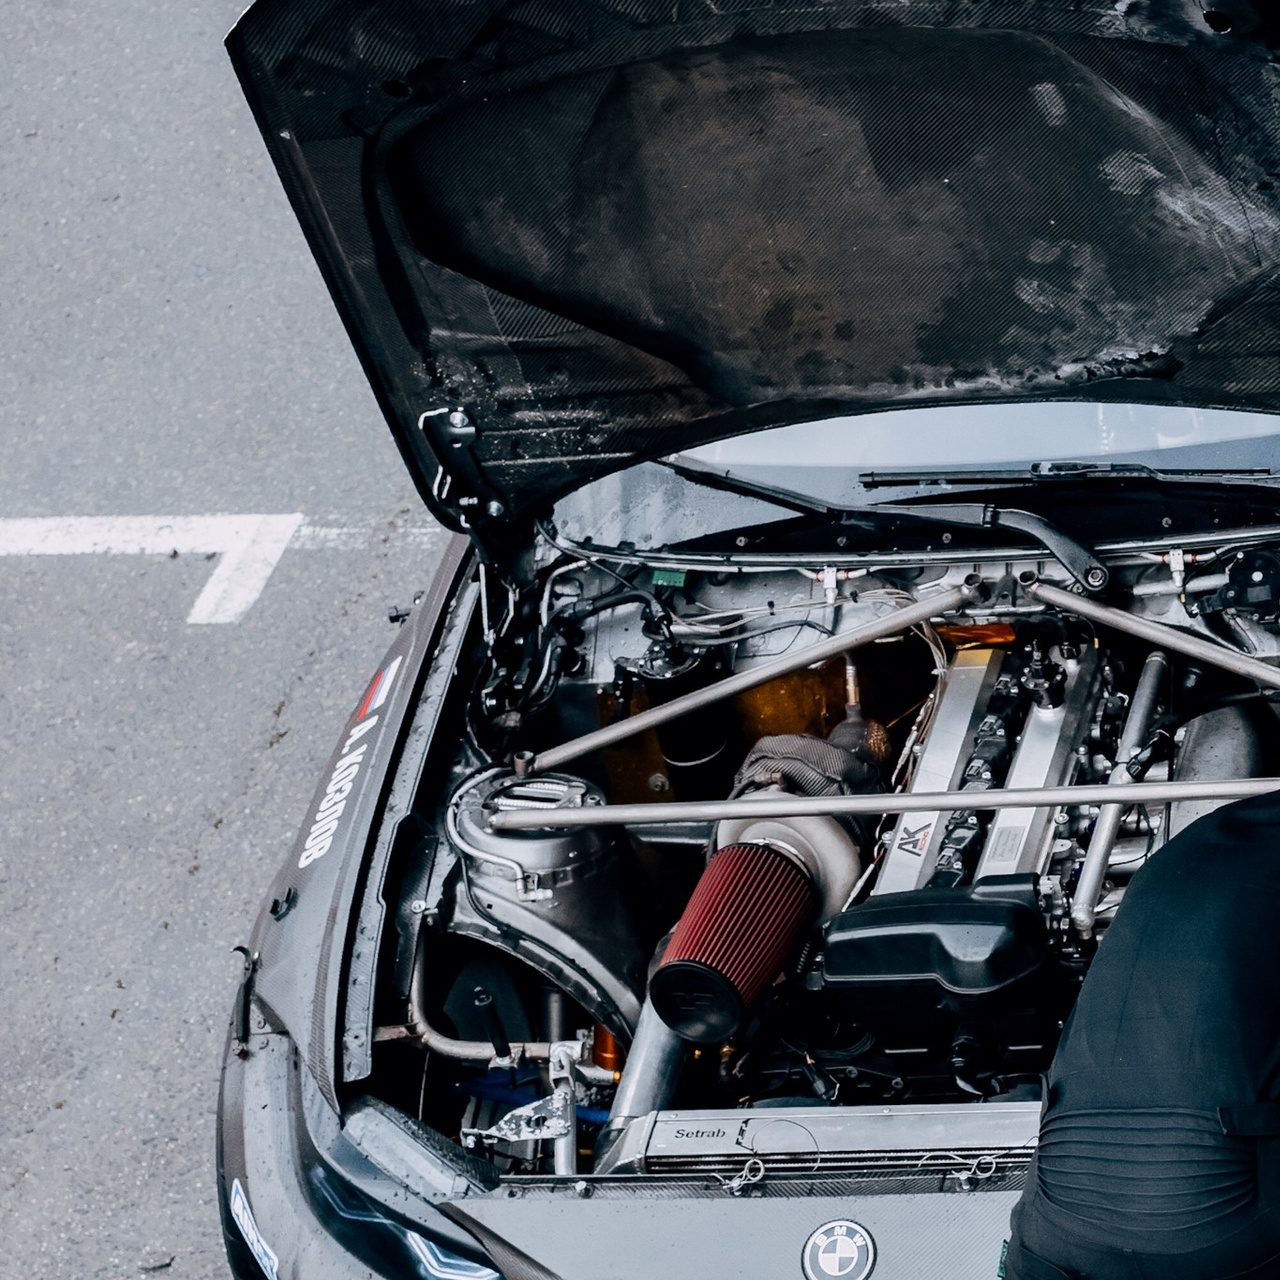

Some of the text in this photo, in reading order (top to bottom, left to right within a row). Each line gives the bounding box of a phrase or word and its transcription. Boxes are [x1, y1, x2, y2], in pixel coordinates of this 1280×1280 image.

[298, 743, 368, 869] КОЗЛОВ
[897, 822, 932, 858] AK
[673, 1127, 727, 1140] Setrab
[814, 1225, 867, 1247] BMW
